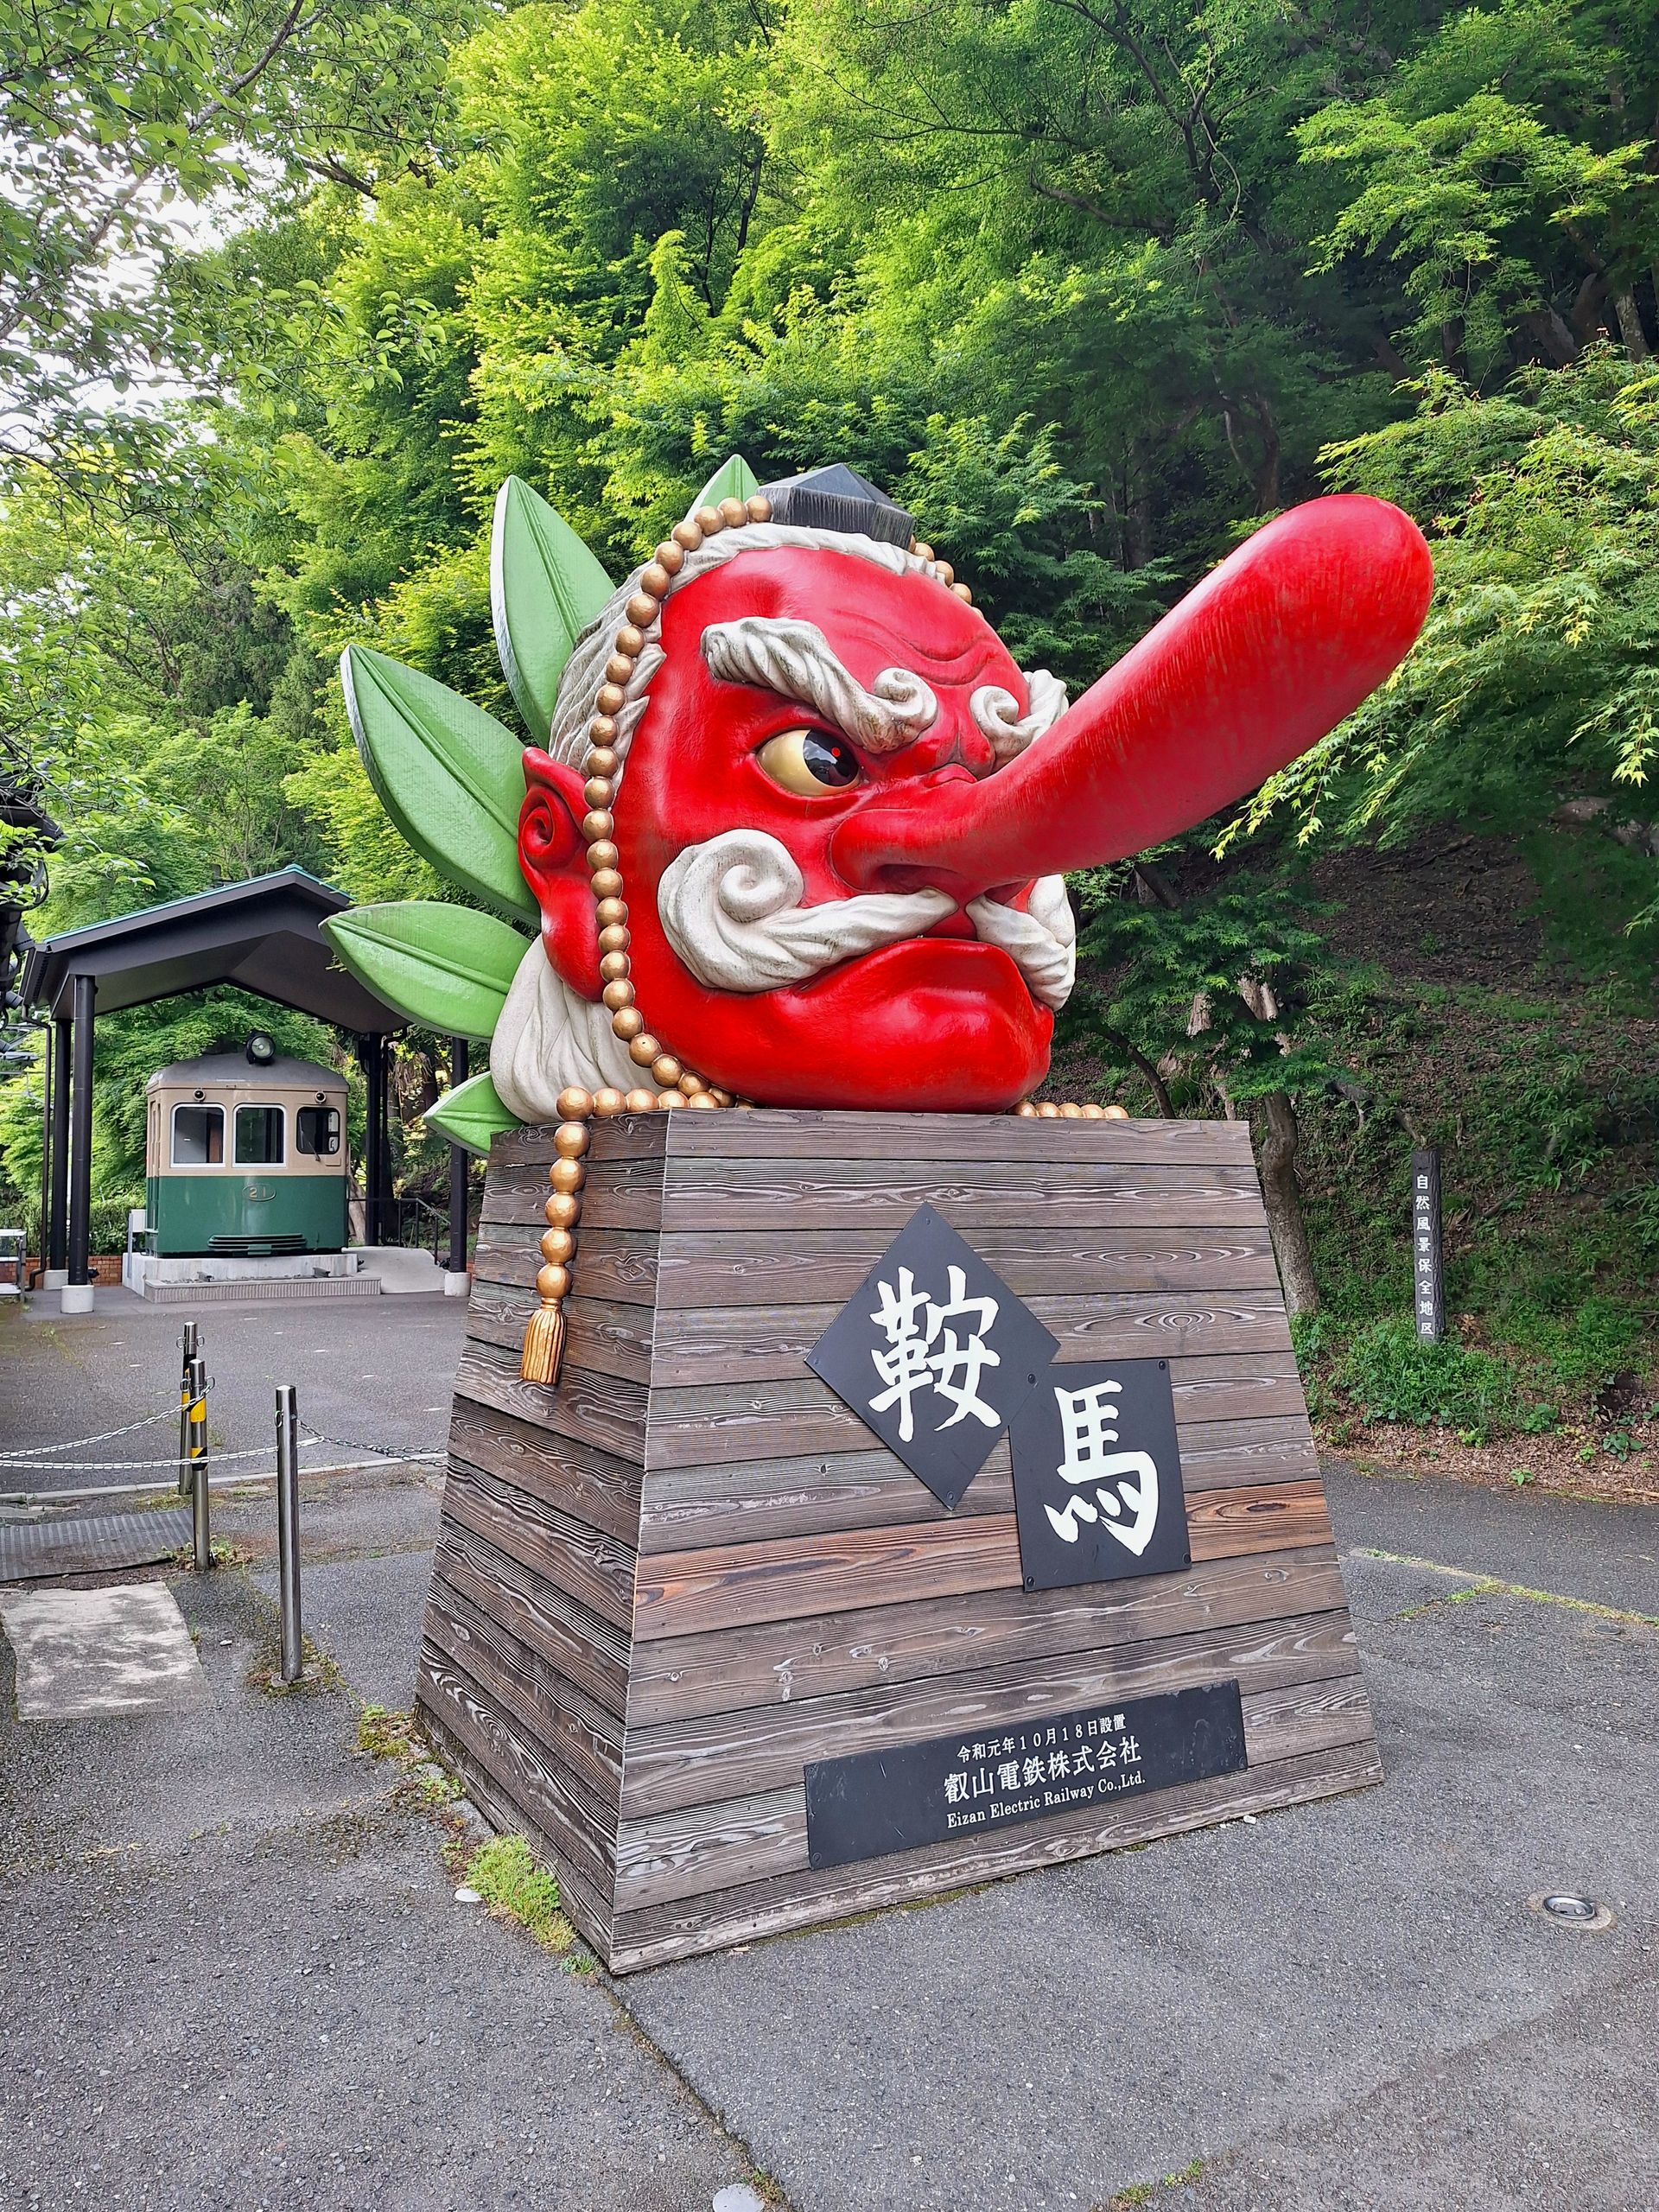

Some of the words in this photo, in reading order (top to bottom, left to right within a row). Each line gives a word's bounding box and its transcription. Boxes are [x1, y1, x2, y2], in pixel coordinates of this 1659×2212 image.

[250, 1186, 266, 1198] 21
[1415, 1174, 1434, 1335] 自然風景保全地区
[868, 1265, 1001, 1443] 鞍
[1043, 1380, 1159, 1556] 馬
[944, 1735, 1142, 1804] 叡山電鉄株式会社
[946, 1808, 986, 1828] Eizan
[989, 1796, 1040, 1819] Electric
[1043, 1783, 1095, 1806] Railway
[1097, 1770, 1146, 1792] Co.,Ltd.
